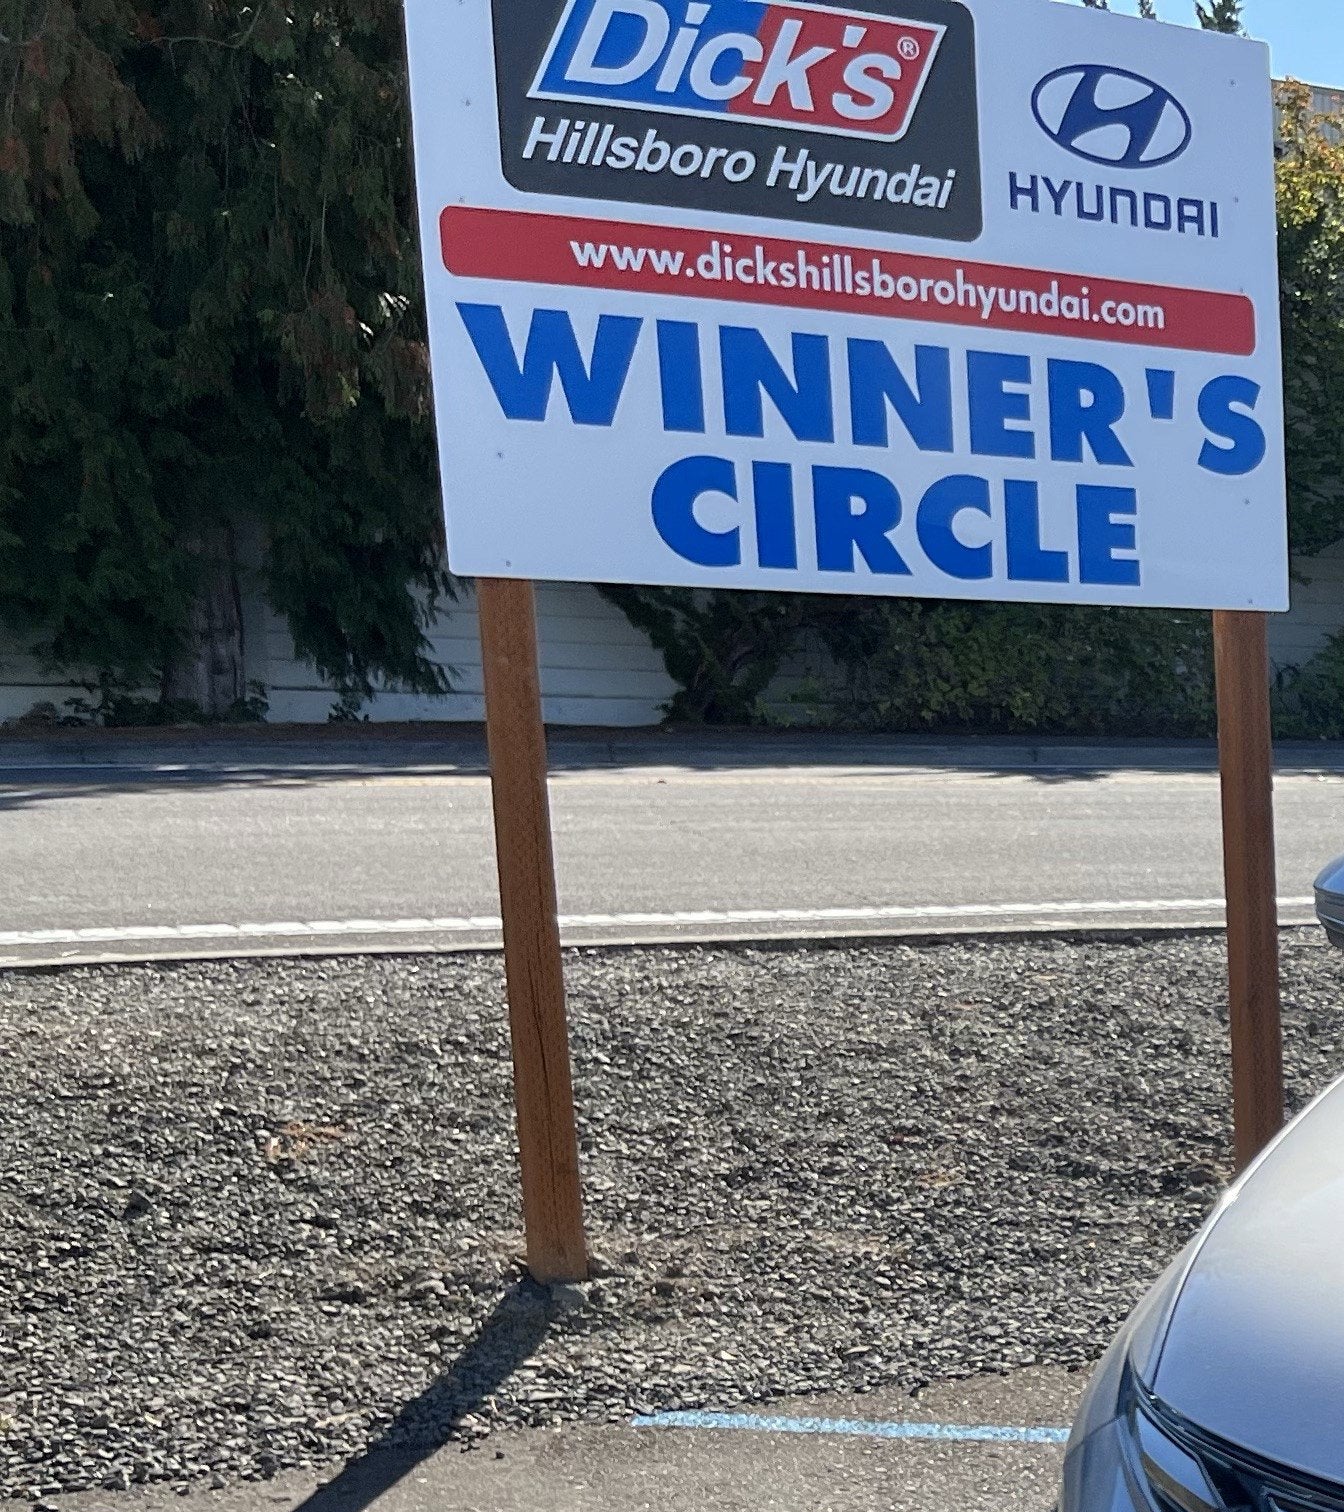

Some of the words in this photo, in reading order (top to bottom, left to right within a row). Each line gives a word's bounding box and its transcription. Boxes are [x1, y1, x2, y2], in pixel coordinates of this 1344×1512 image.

[563, 0, 903, 121] Dick's
[521, 115, 757, 183] Hillsboro
[765, 145, 958, 209] Hyundai
[1008, 170, 1219, 238] HYUNDAI
[570, 237, 1166, 331] www.dickshillsborohyundai.com
[455, 302, 1266, 477] WINNER'S
[651, 455, 1142, 588] CIRCLE
